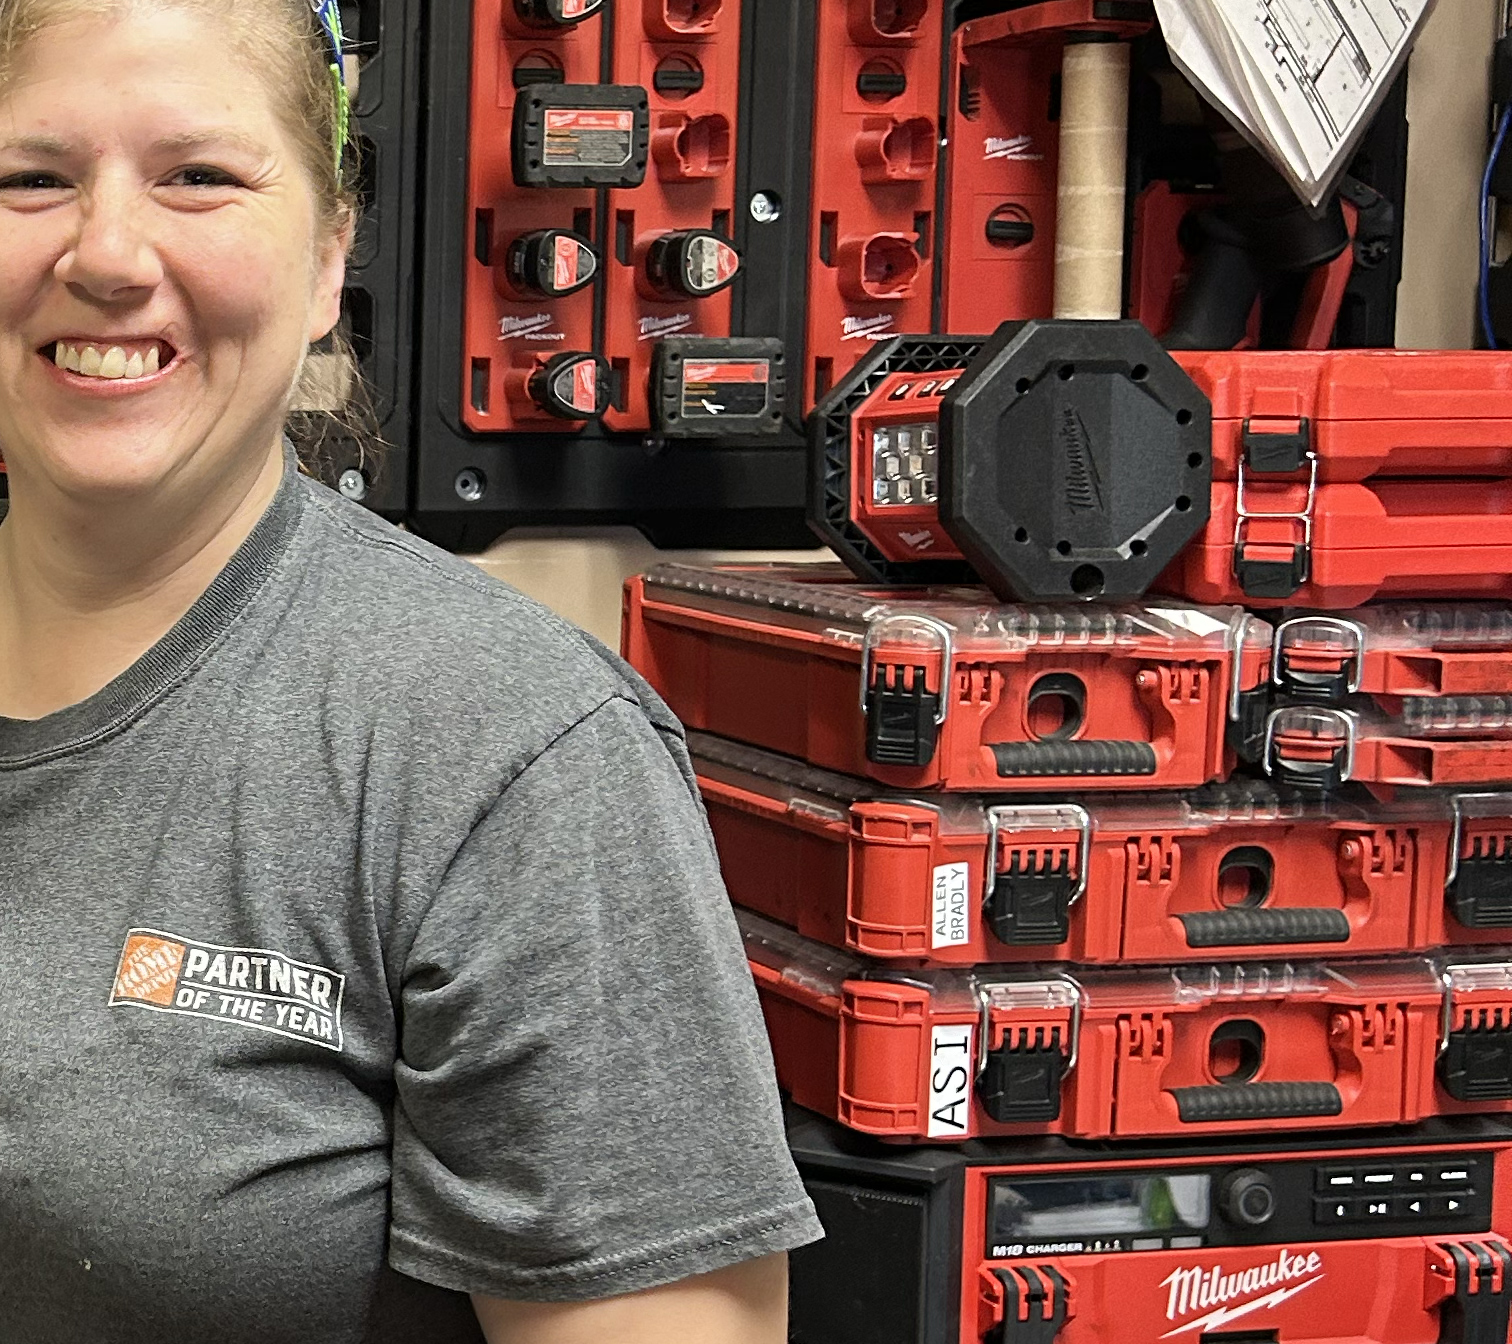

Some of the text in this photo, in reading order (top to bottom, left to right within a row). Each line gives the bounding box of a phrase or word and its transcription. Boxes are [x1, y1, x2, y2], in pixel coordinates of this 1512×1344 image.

[501, 313, 552, 333] Milwaukee
[638, 313, 691, 333] Milwaukee
[1063, 408, 1094, 516] Milwaukee
[935, 874, 948, 937] ALLEN
[950, 867, 966, 943] BRADLY
[185, 948, 331, 1009] PARTNER
[176, 988, 333, 1041] OF THE YEAR
[932, 1036, 969, 1130] ASI
[992, 1243, 1083, 1256] M18 CHARGER
[1158, 1248, 1322, 1320] Milwaukee
